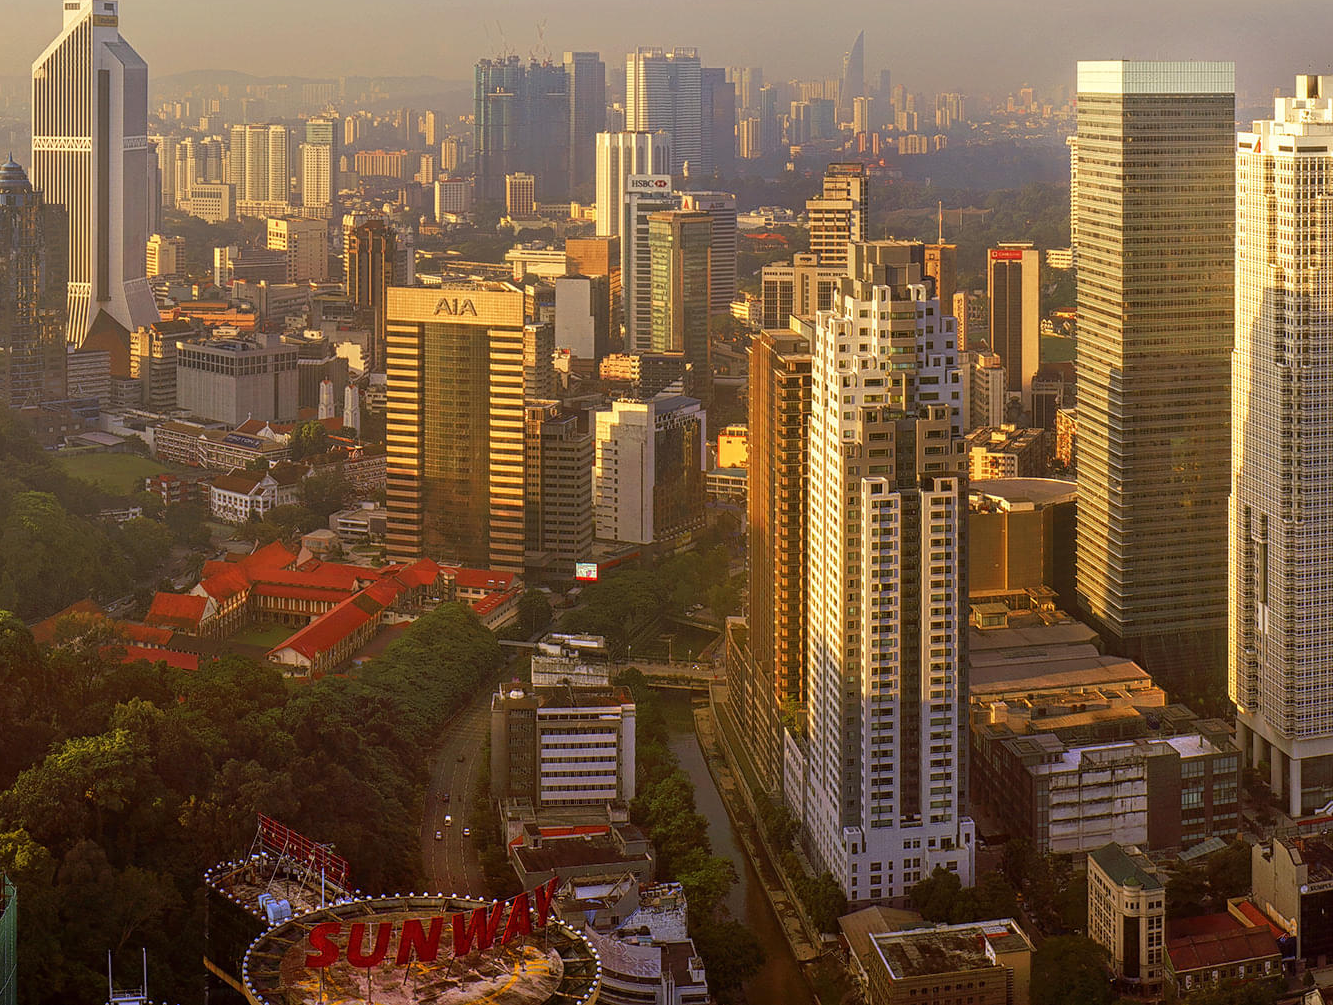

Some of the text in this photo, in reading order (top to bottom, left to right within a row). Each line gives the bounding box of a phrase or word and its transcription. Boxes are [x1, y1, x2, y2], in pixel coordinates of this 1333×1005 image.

[632, 179, 654, 188] HSBC
[433, 297, 477, 316] AIA
[305, 875, 560, 968] SUNWAY
